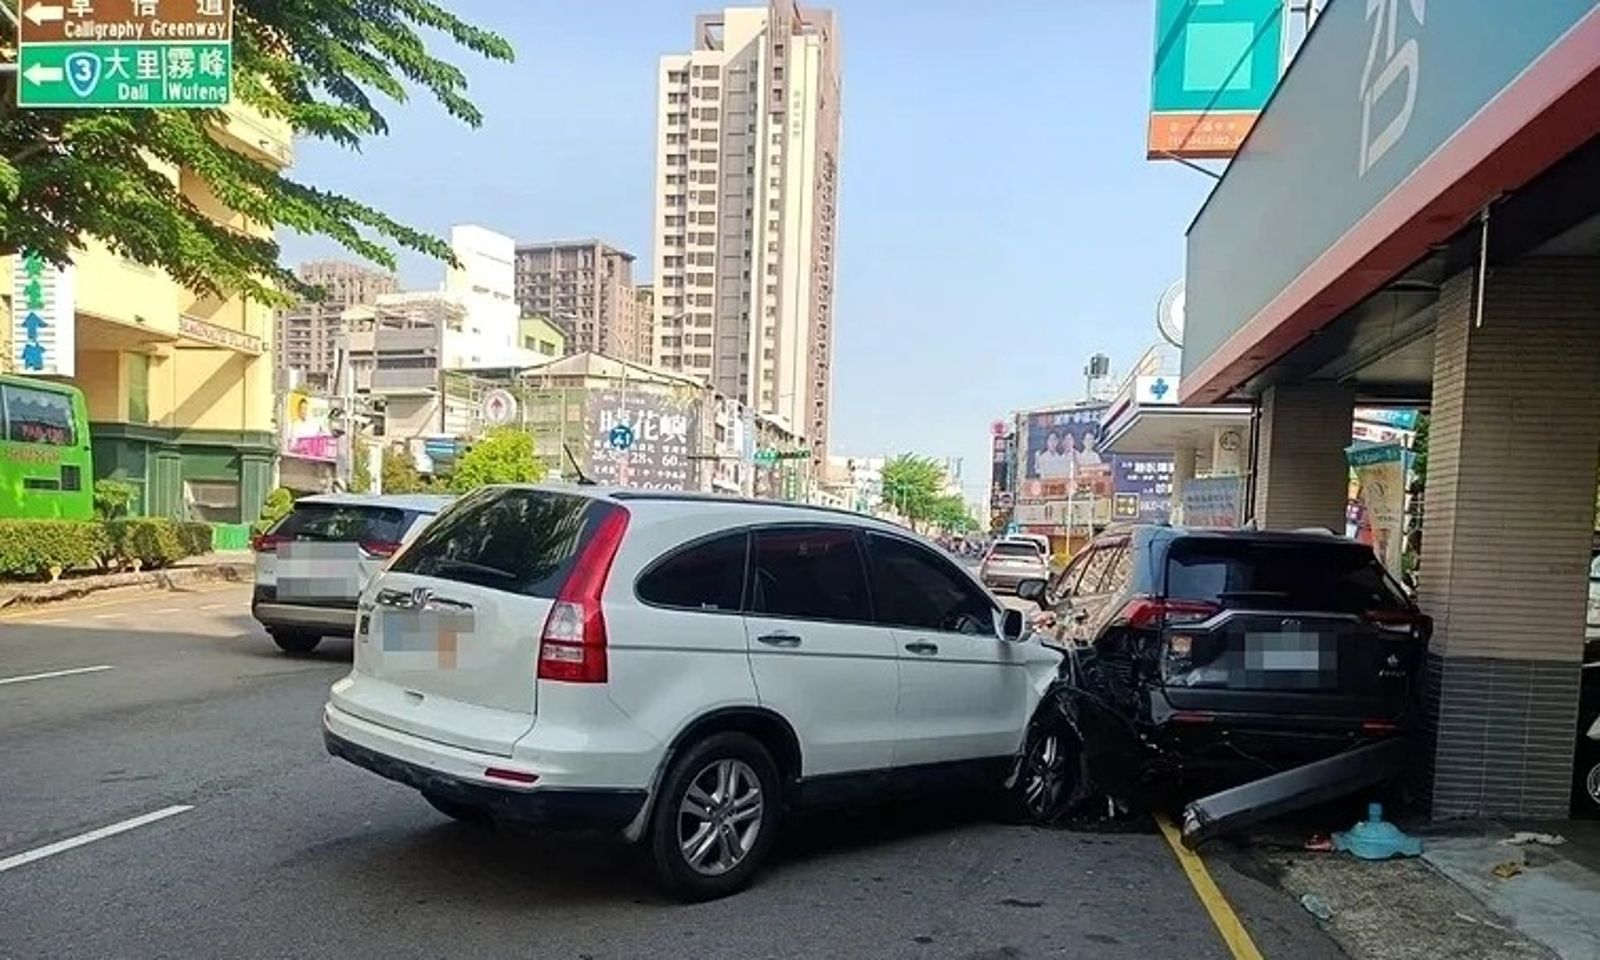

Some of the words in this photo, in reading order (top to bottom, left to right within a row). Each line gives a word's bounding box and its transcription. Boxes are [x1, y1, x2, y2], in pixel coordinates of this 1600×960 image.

[65, 21, 144, 40] Calligraphy
[151, 19, 226, 39] Greenway
[75, 58, 92, 81] 3
[104, 48, 161, 79] 大里
[168, 48, 226, 79] 霧峰
[118, 82, 149, 100] Dali
[169, 83, 227, 102] Wufeng
